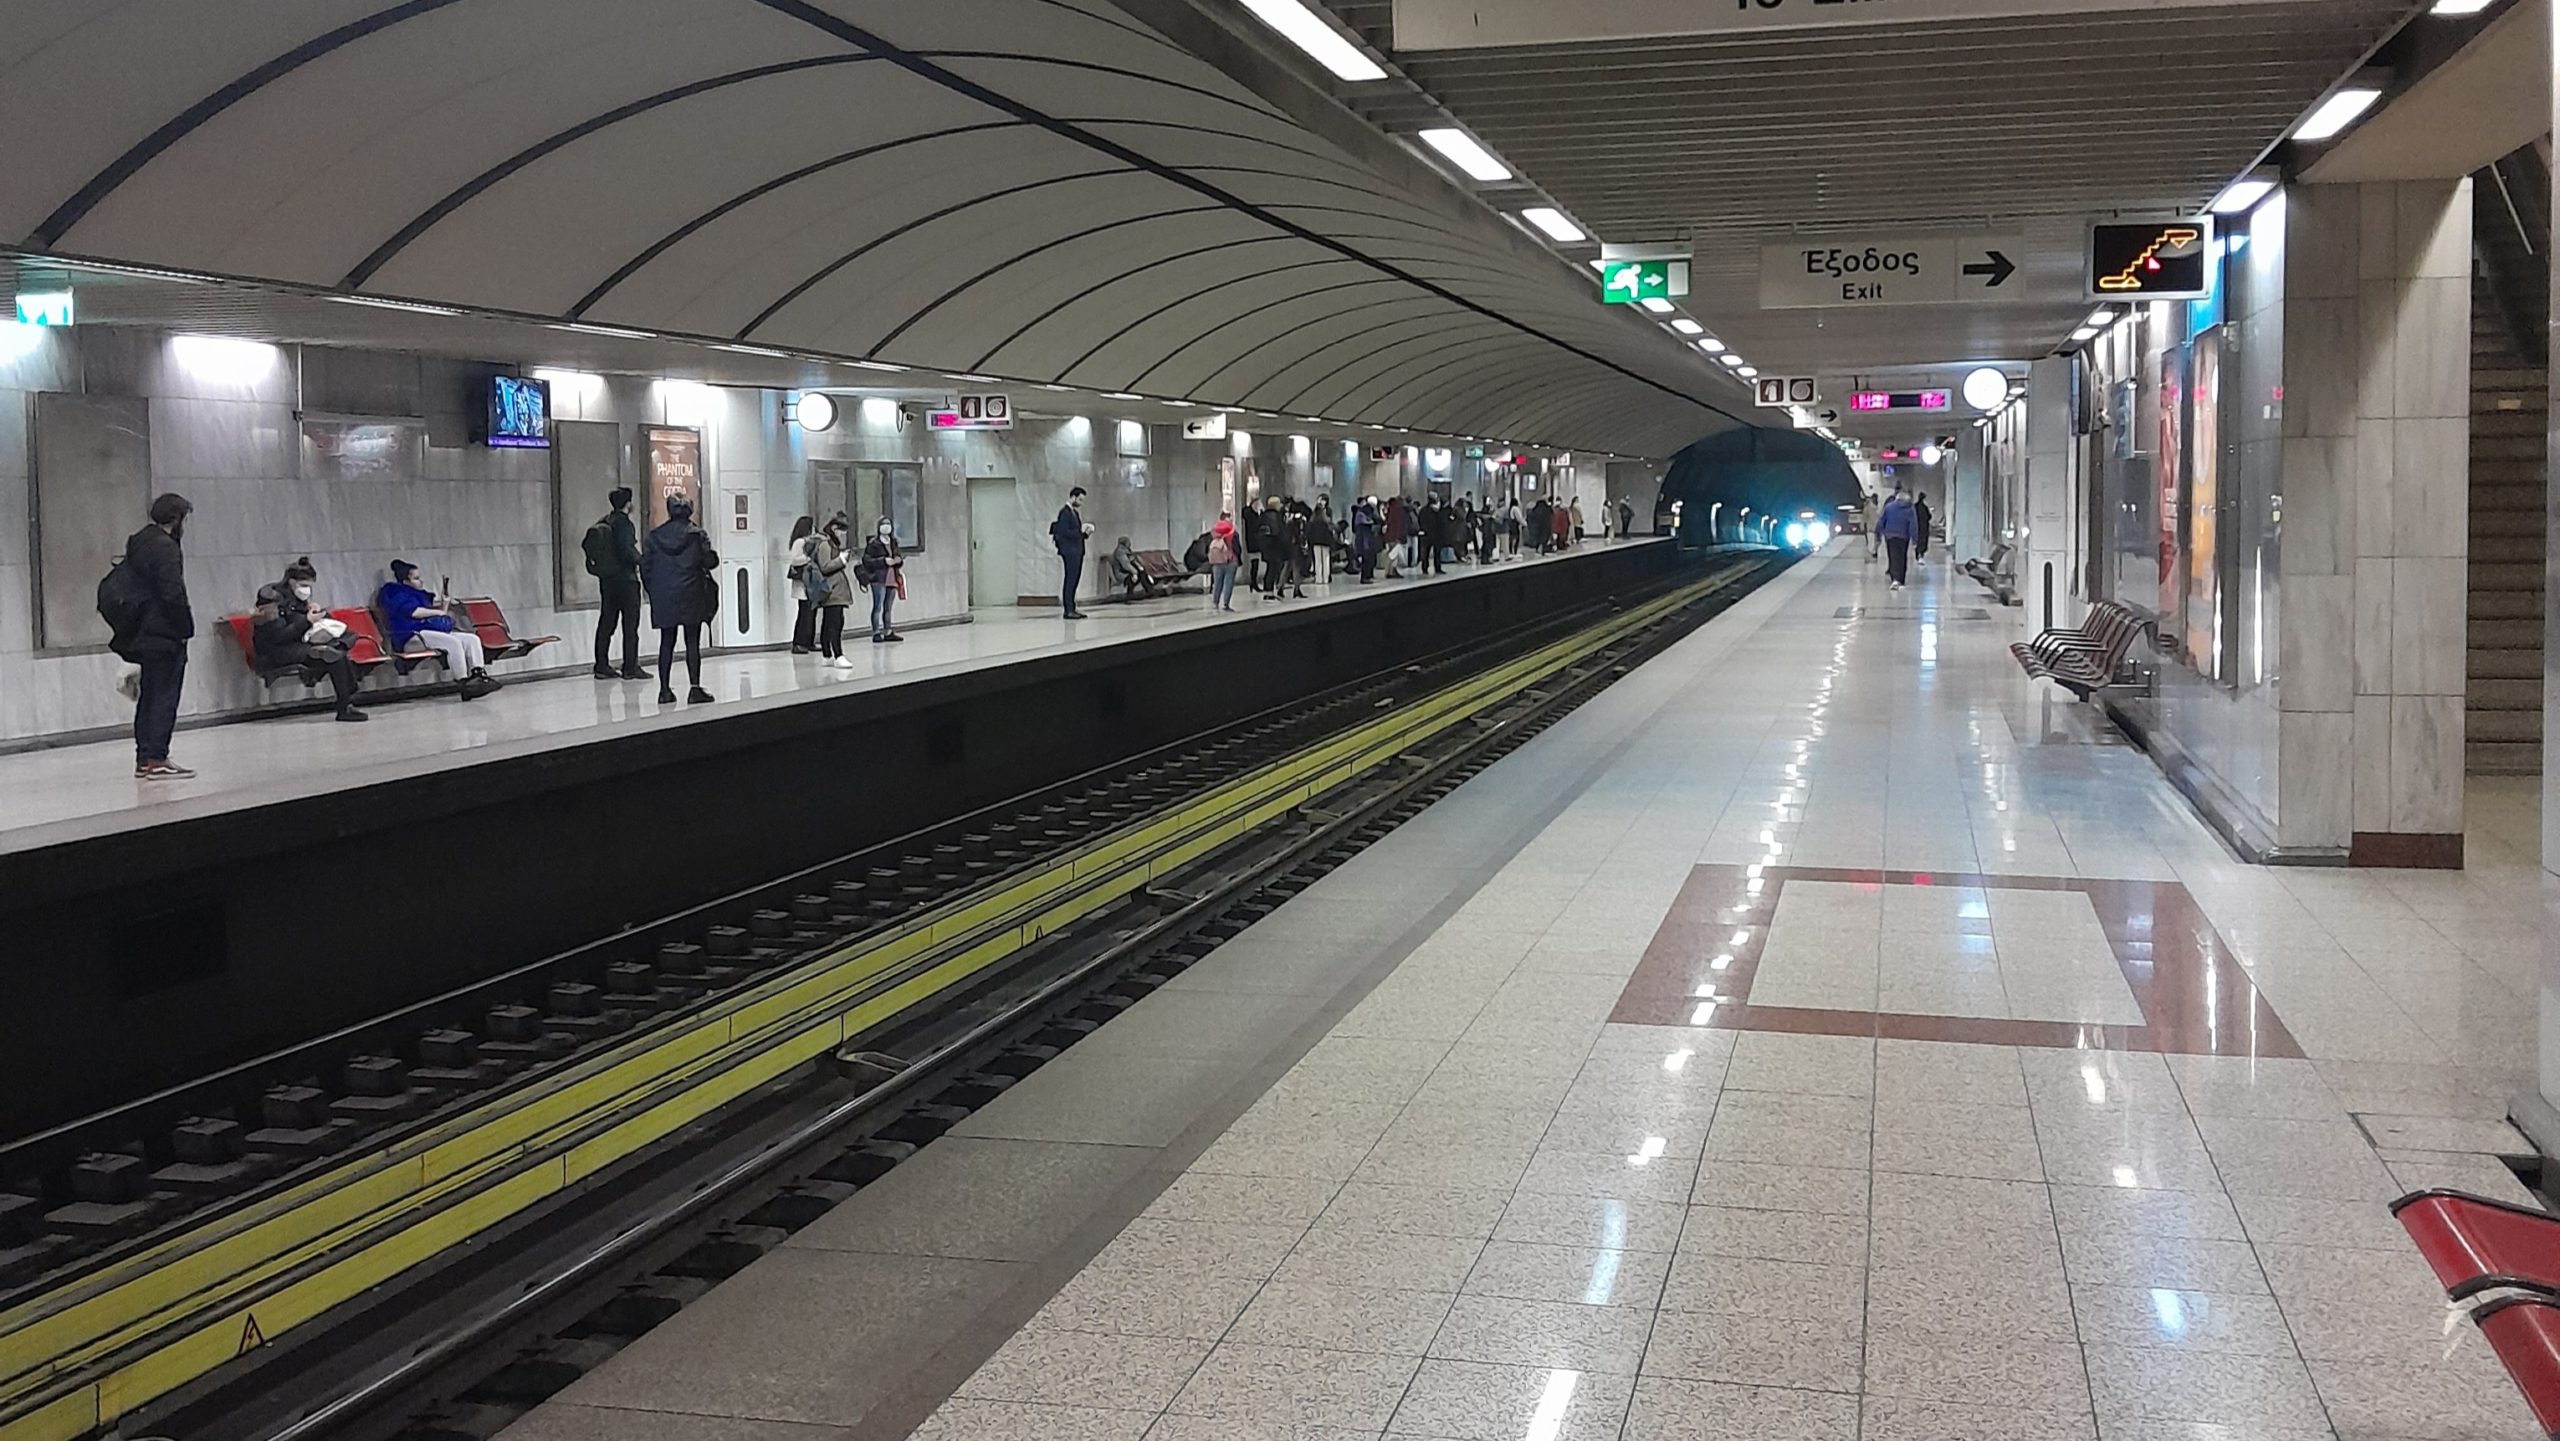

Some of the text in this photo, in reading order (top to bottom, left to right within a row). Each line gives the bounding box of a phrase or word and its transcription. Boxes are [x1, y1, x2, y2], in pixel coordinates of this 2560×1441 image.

[1801, 247, 1919, 278] Έξοδος
[1842, 282, 1882, 300] Exit
[657, 462, 694, 477] PHANTOM
